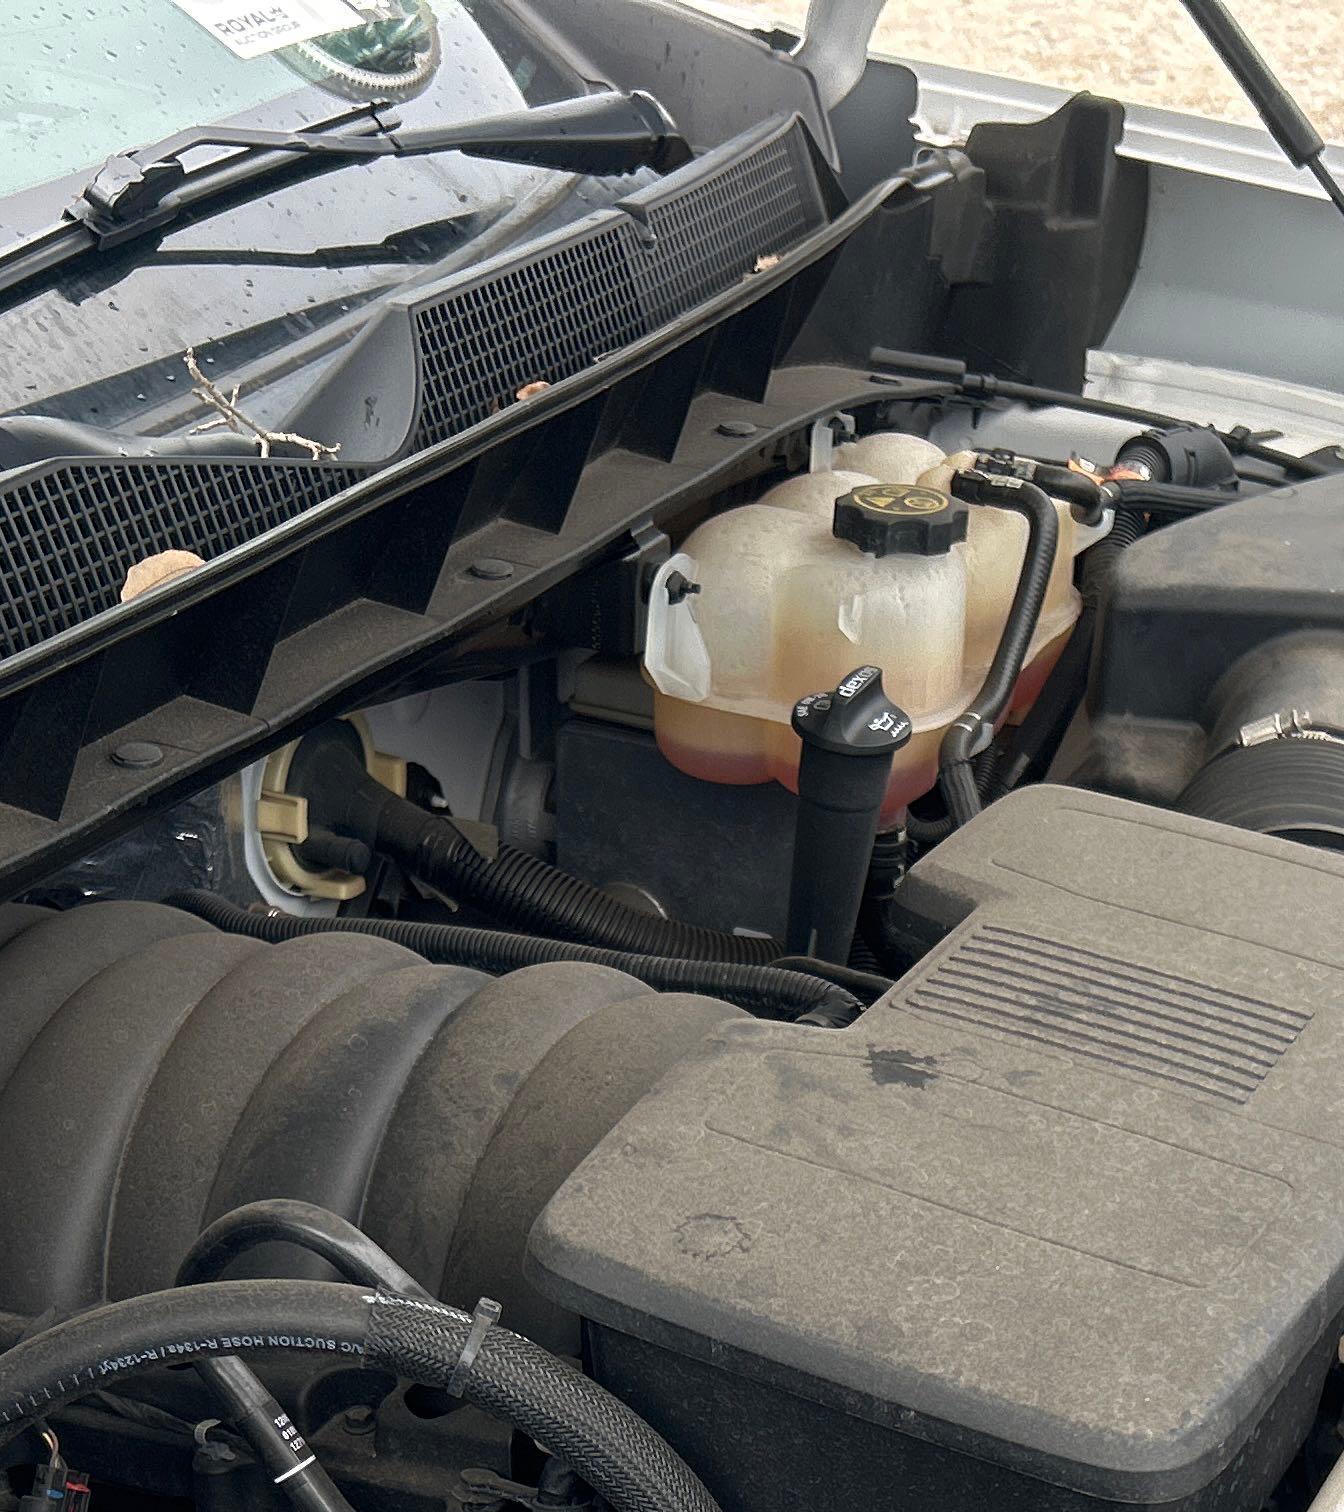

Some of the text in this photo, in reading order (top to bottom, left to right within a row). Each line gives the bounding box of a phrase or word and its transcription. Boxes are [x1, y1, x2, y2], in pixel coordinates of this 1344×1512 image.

[214, 10, 276, 37] ROYAL
[167, 1337, 218, 1355] R-134a
[220, 1335, 264, 1348] HOSE
[268, 1335, 336, 1351] SUCTION
